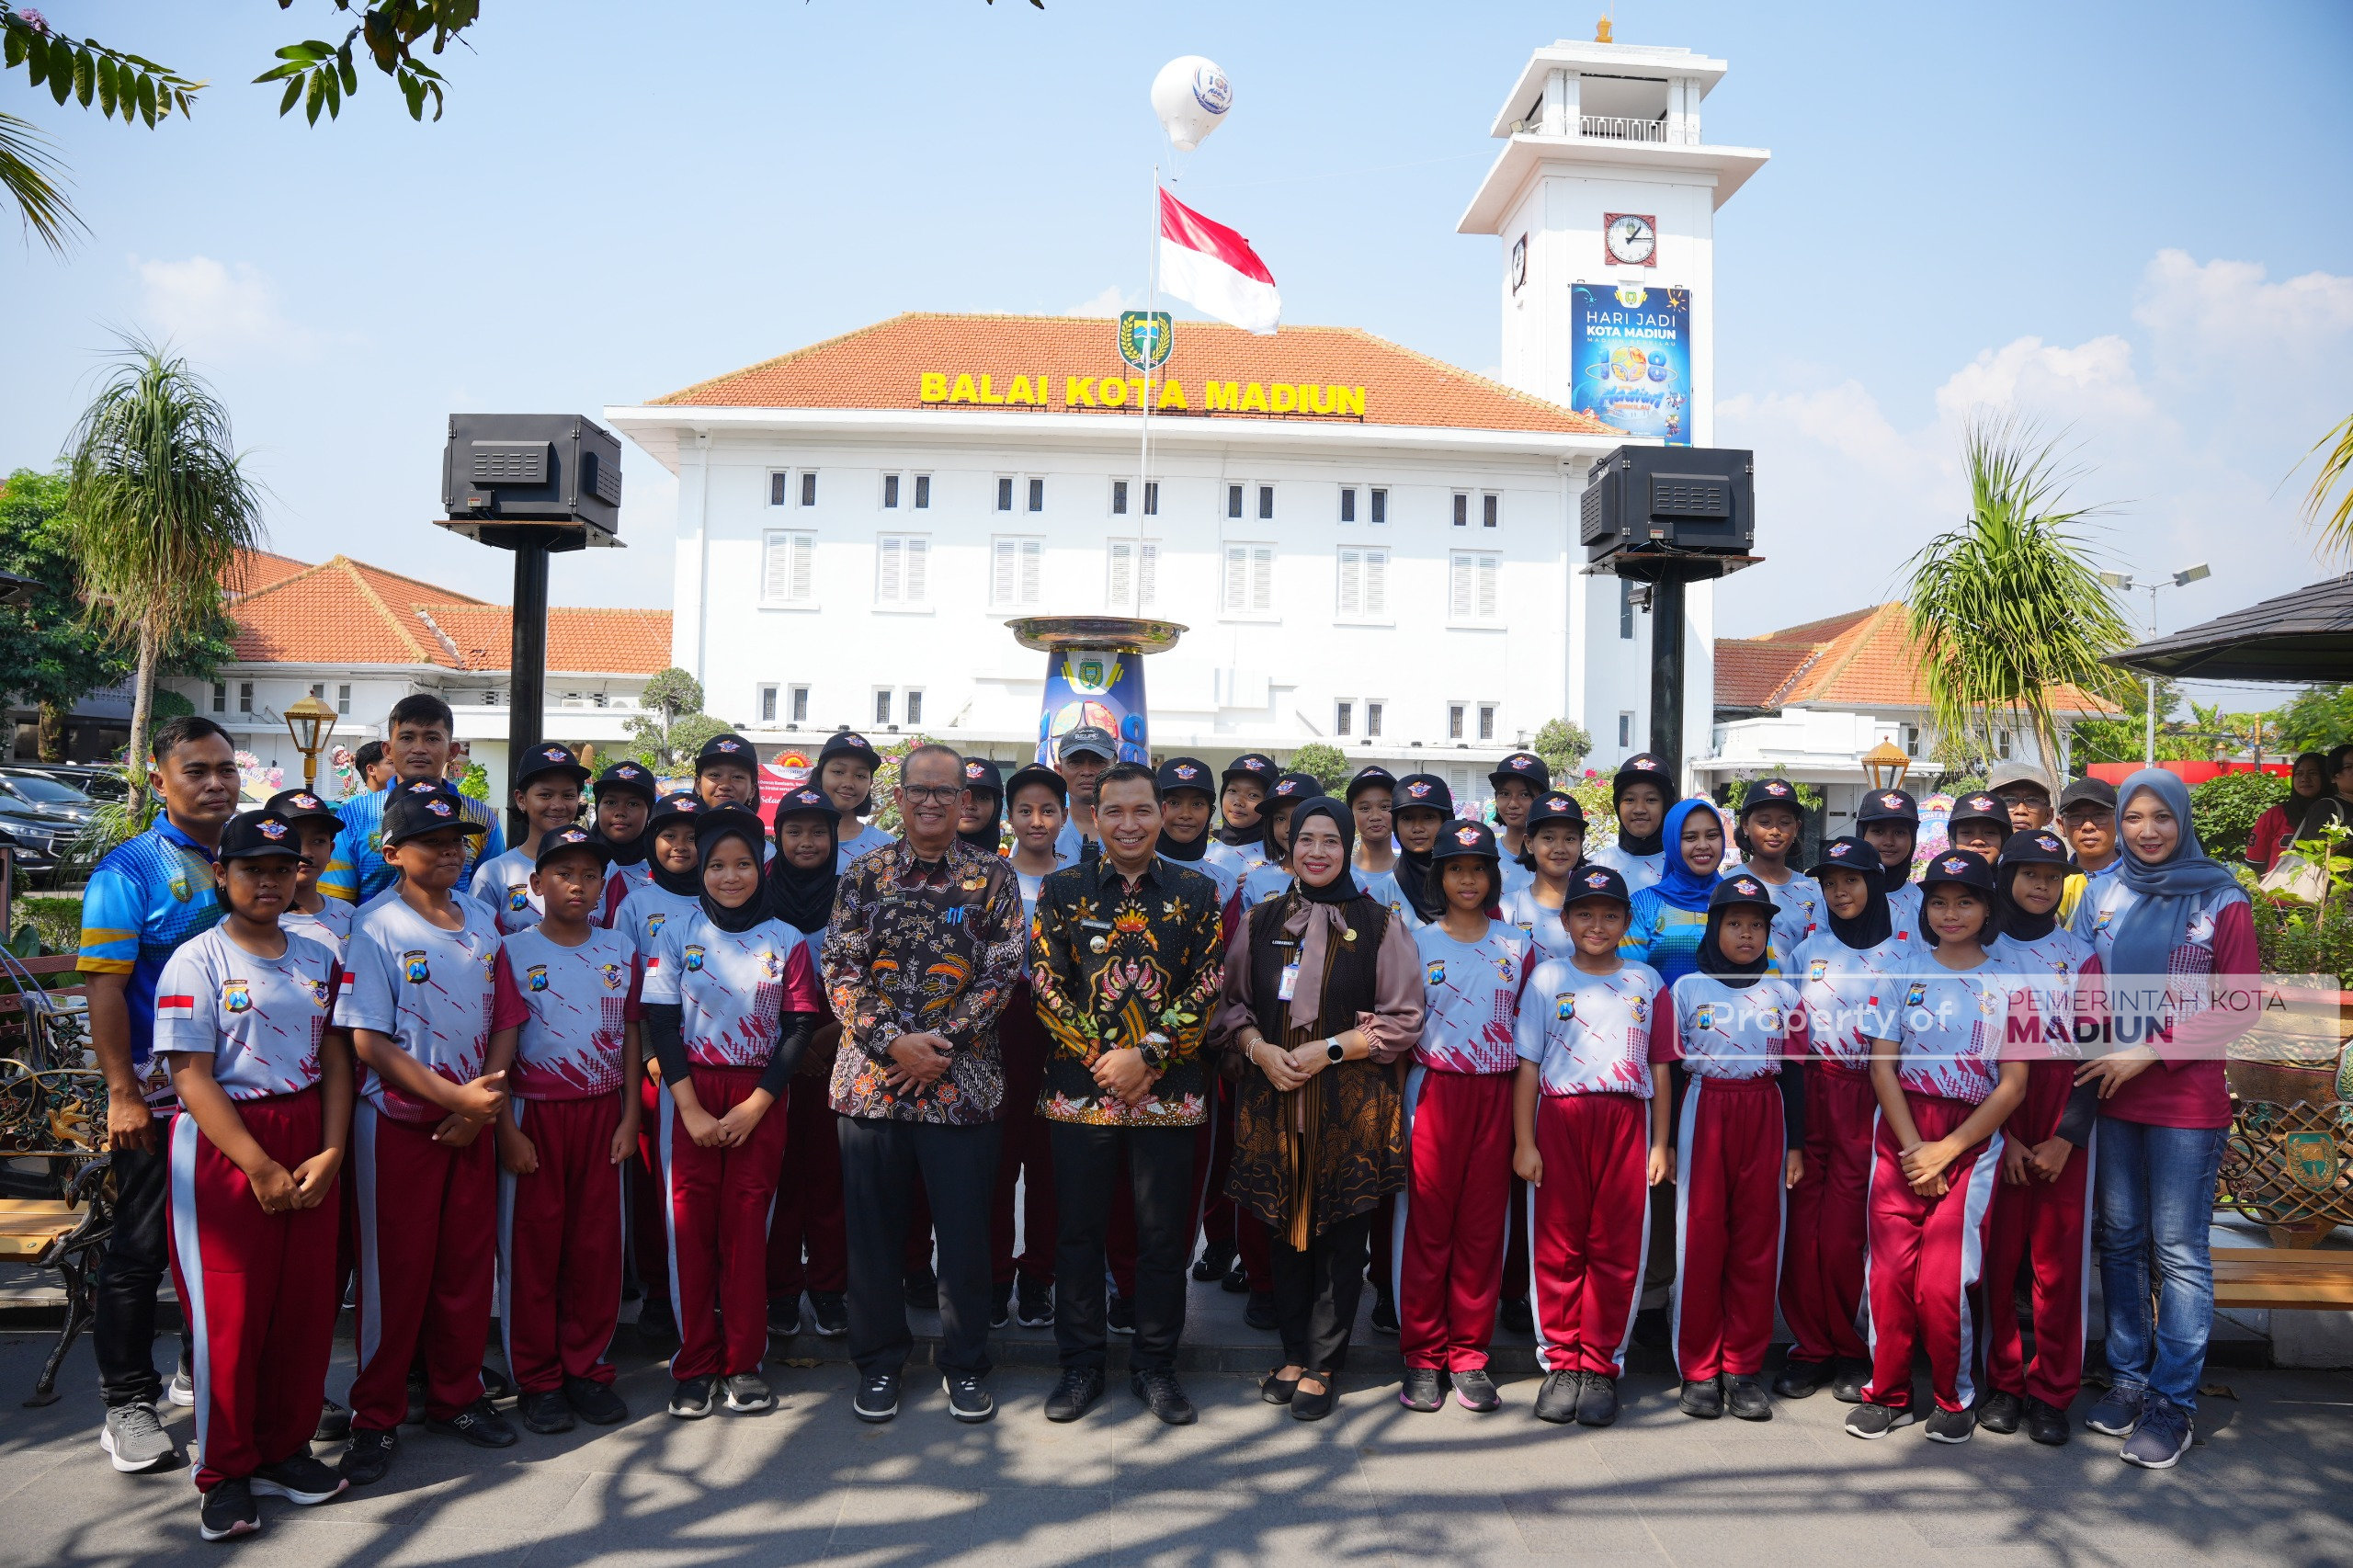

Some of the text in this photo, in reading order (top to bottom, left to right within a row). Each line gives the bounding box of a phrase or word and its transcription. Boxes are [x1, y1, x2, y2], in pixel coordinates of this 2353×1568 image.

[1586, 311, 1676, 327] HARI JADI
[1586, 325, 1676, 339] KOTA MADIUN
[920, 371, 1365, 415] BALAI KOTA MADIUN
